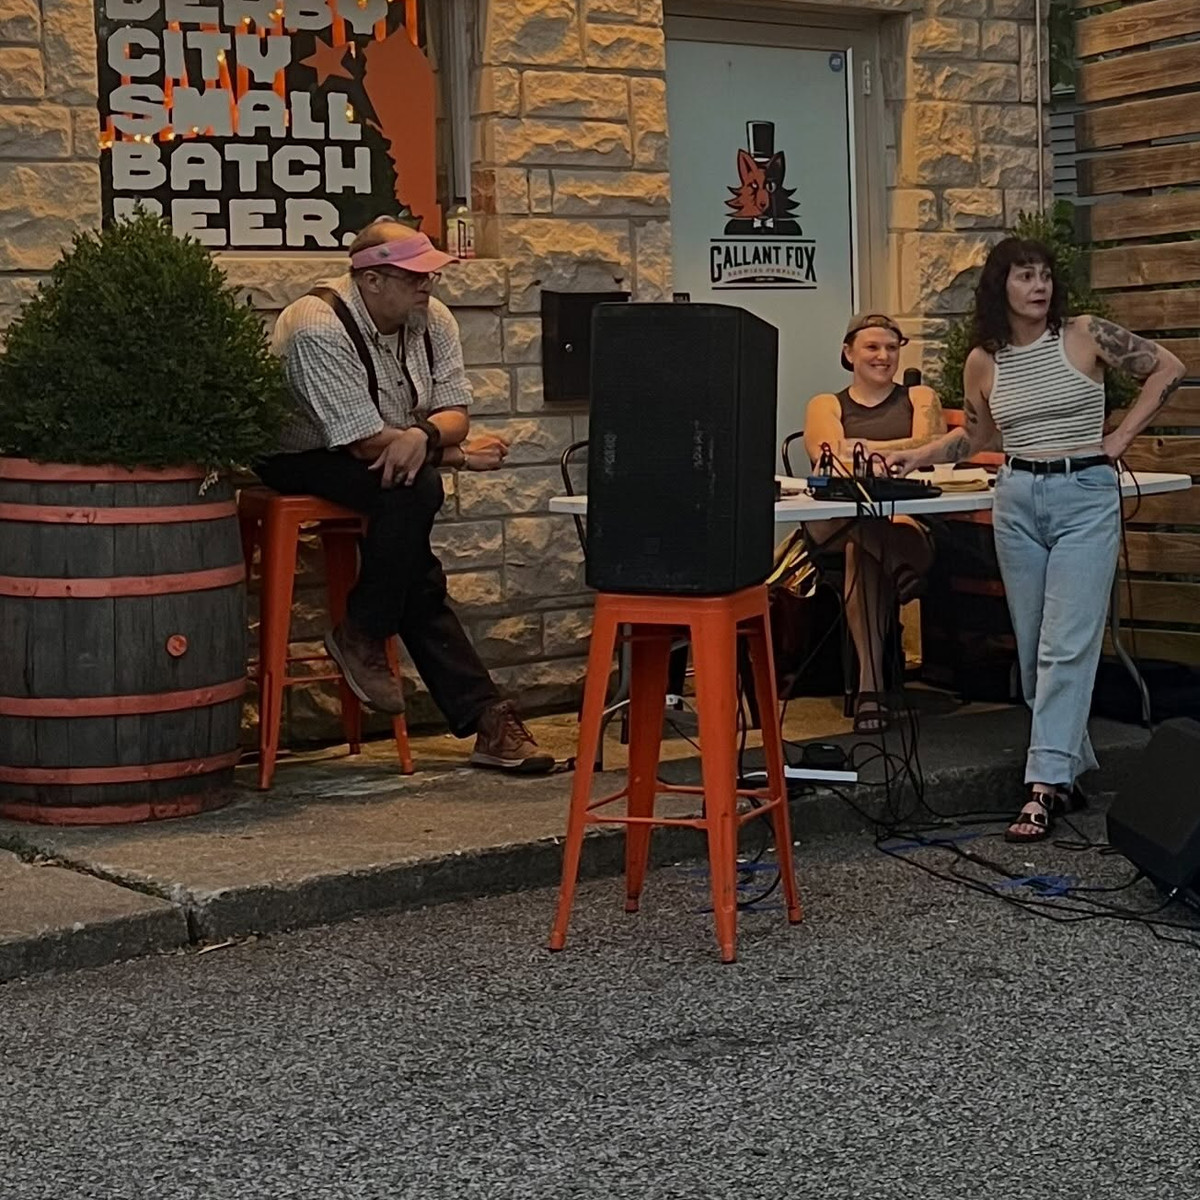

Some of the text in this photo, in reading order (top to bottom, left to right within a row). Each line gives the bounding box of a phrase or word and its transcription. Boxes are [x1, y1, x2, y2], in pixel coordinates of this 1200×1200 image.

[107, 26, 292, 84] CITY
[109, 83, 362, 141] SMALL
[112, 141, 372, 195] BATCH
[710, 245, 817, 283] GALLANT FOX
